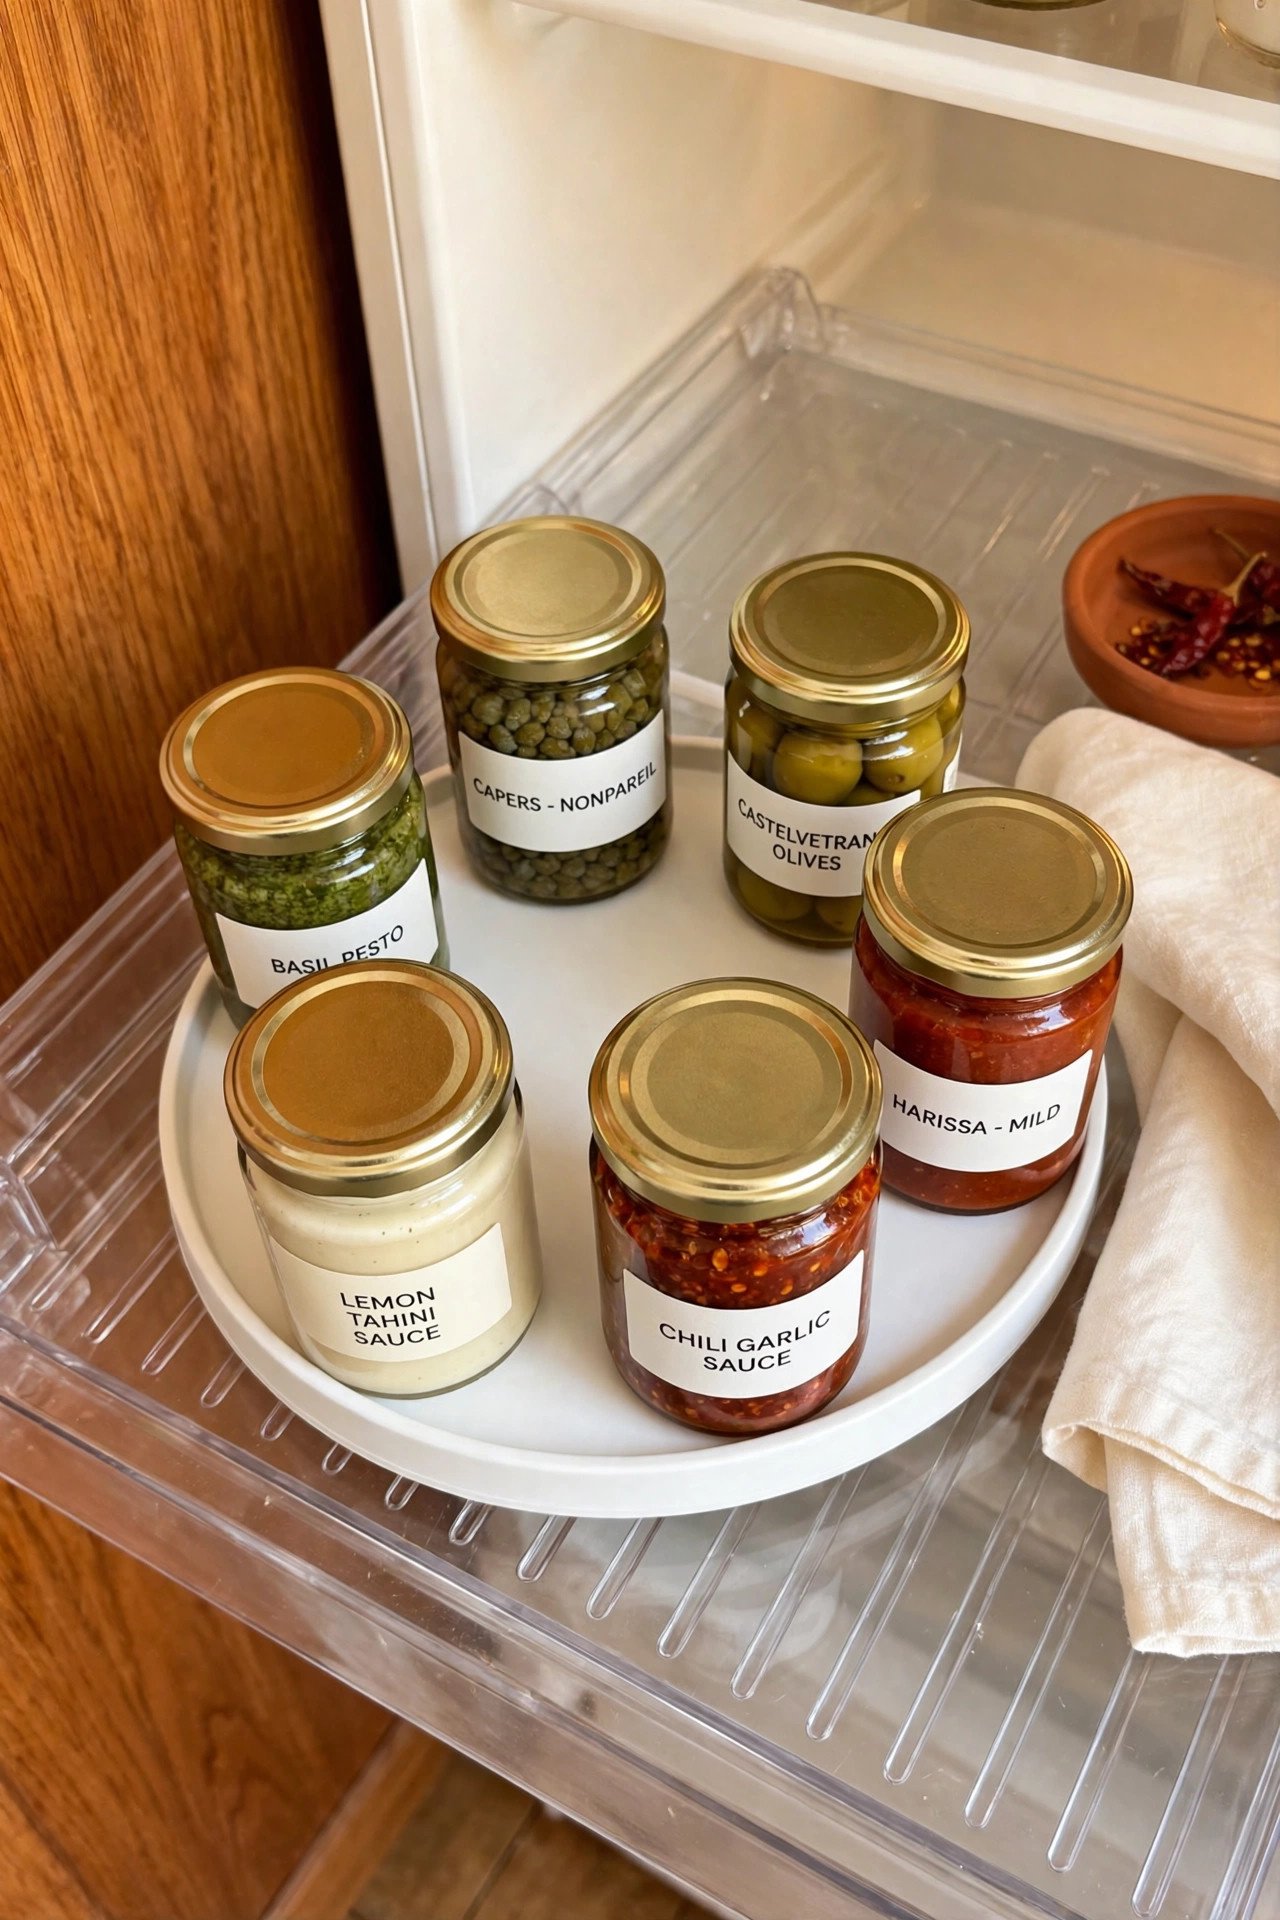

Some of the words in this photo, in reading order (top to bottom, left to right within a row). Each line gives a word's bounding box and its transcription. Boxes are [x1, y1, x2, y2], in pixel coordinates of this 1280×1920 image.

[473, 777, 541, 812] CAPERS
[560, 761, 657, 812] NONPAREIL
[738, 798, 876, 850] CASTELVETRAN
[773, 844, 841, 871] OLIVES
[342, 925, 404, 962] PESTO
[893, 1093, 987, 1135] HARISSA
[1009, 1103, 1061, 1133] MILD
[340, 1286, 435, 1310] LEMON
[346, 1306, 435, 1328] TAHINI
[659, 1323, 726, 1353] CHILI
[736, 1310, 831, 1353] GARLIC
[354, 1324, 441, 1346] SAUCE
[703, 1349, 791, 1372] SAUCE
